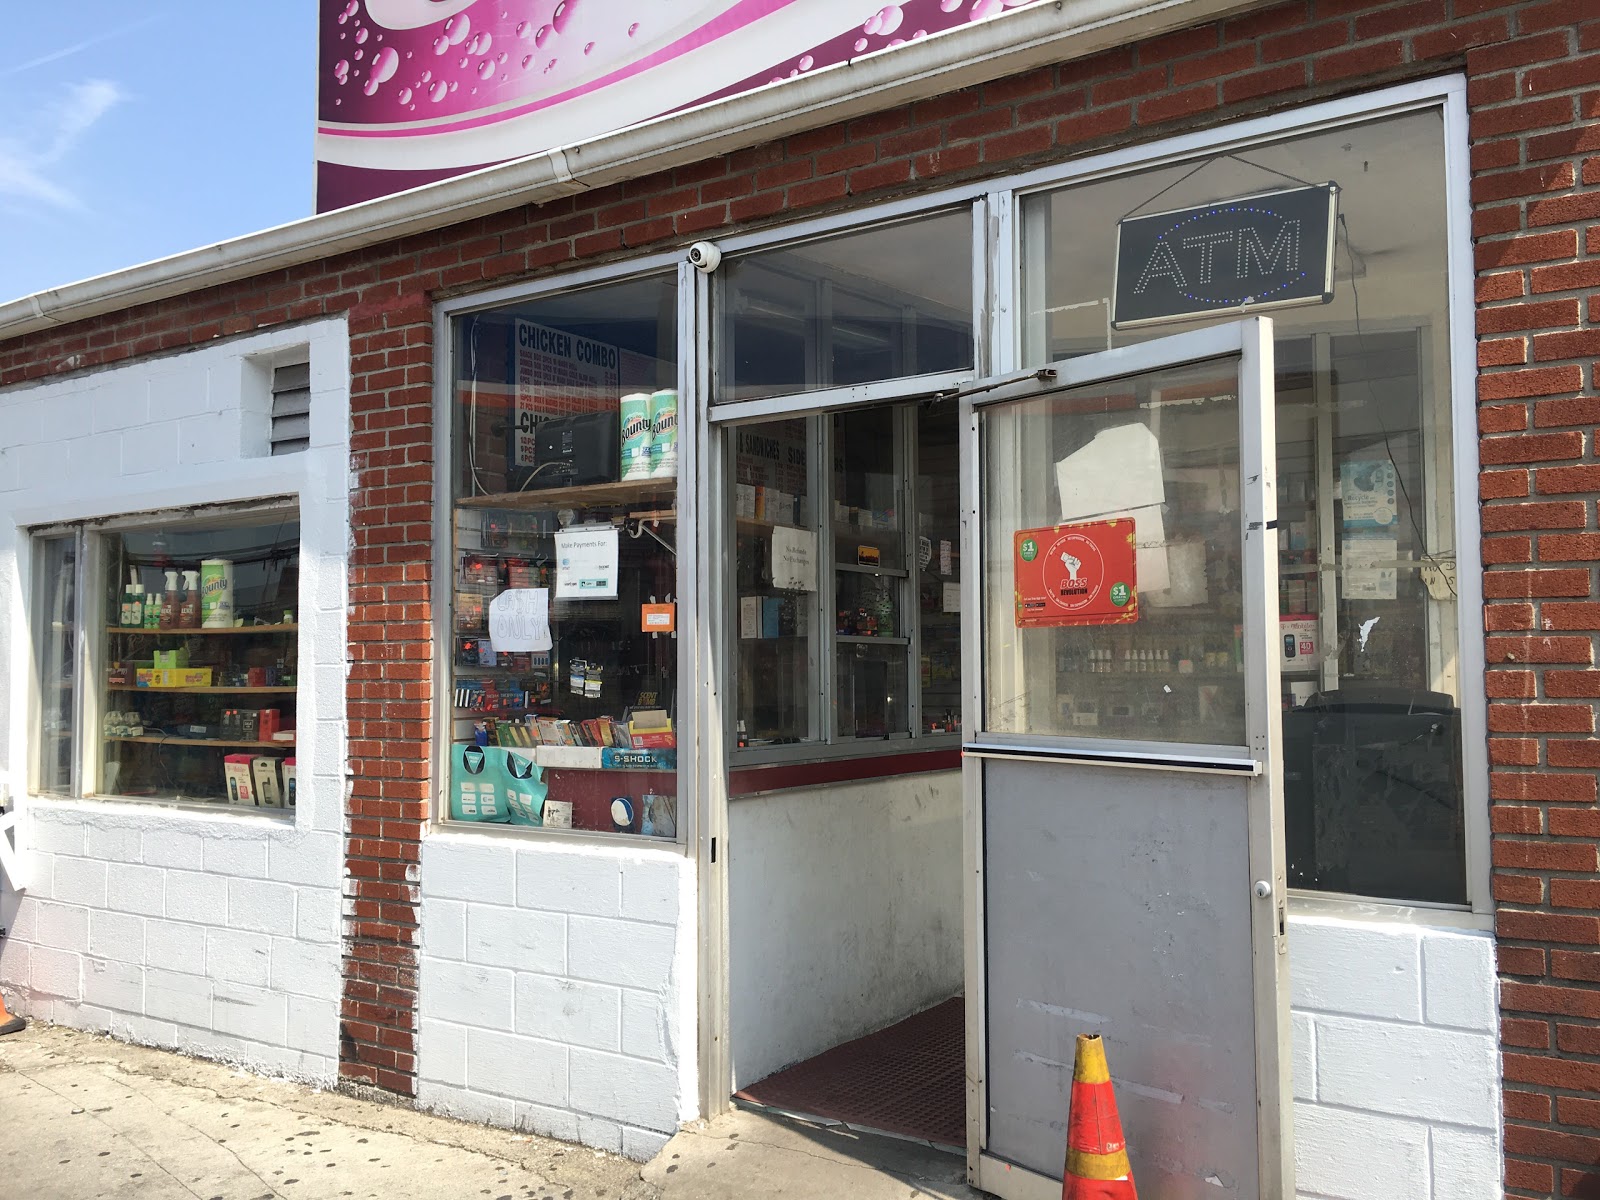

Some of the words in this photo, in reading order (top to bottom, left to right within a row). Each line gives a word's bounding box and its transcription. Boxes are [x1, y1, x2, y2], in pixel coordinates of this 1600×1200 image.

[1133, 219, 1302, 295] ATM
[519, 323, 571, 358] CHICKEN
[576, 339, 617, 370] COMBO
[621, 418, 652, 447] Bounty
[652, 414, 678, 442] Bount
[573, 541, 597, 549] Payments
[1022, 541, 1035, 552] $1
[1060, 577, 1088, 589] BOSS
[1060, 587, 1088, 596] REVOLUTION
[1112, 584, 1127, 596] $1
[614, 755, 658, 763] S-SHOCK
